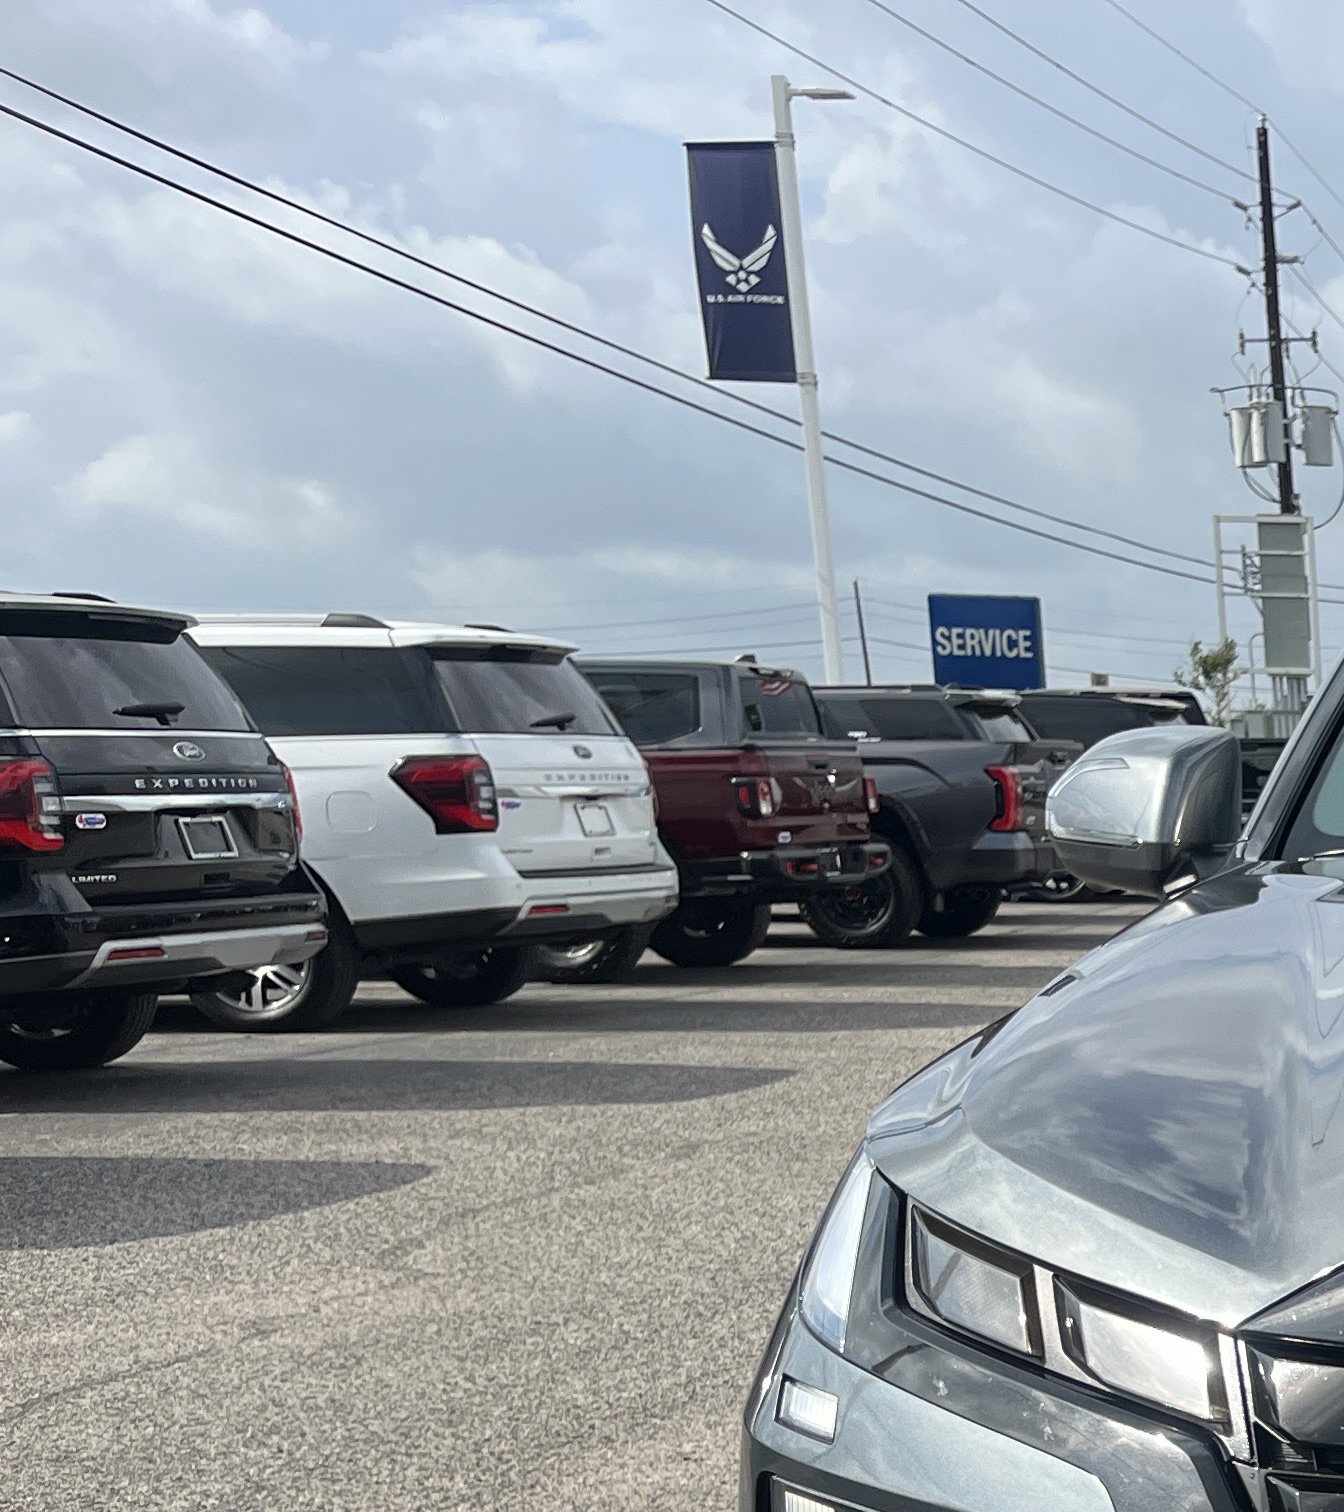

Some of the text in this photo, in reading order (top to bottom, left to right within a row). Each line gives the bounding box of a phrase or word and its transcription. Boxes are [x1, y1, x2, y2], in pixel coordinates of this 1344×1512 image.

[746, 294, 786, 305] FORCE
[934, 626, 1034, 659] SERVICE
[134, 777, 258, 790] EXPEDITION
